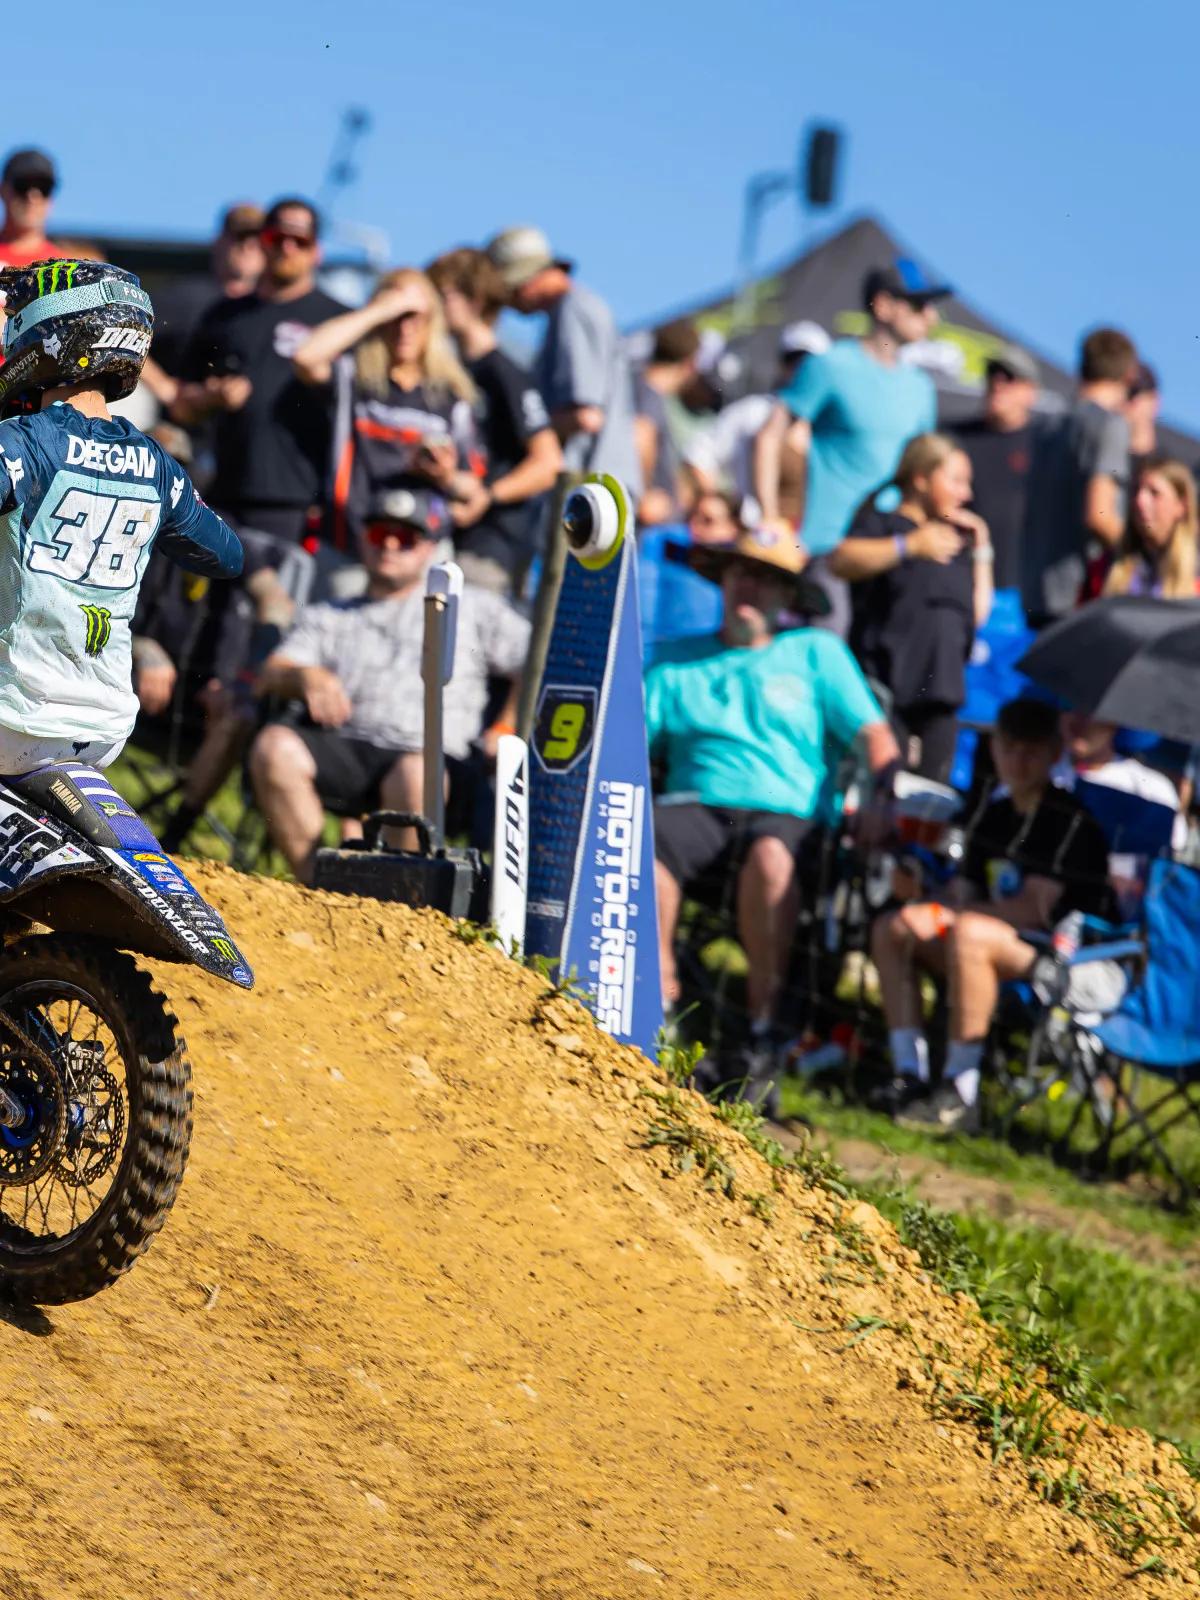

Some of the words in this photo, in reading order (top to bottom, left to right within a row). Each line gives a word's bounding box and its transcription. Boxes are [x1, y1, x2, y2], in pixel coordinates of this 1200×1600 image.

[122, 287, 144, 302] FOX
[3, 350, 40, 381] MONSTER
[65, 434, 156, 478] DEEGAN
[28, 486, 161, 590] 38
[543, 703, 586, 760] 9
[50, 779, 83, 815] YAMAHA
[504, 797, 520, 887] UFO
[138, 886, 210, 954] DUNLOP
[596, 782, 634, 1035] MOTOCROSS
[625, 877, 641, 944] PRO
